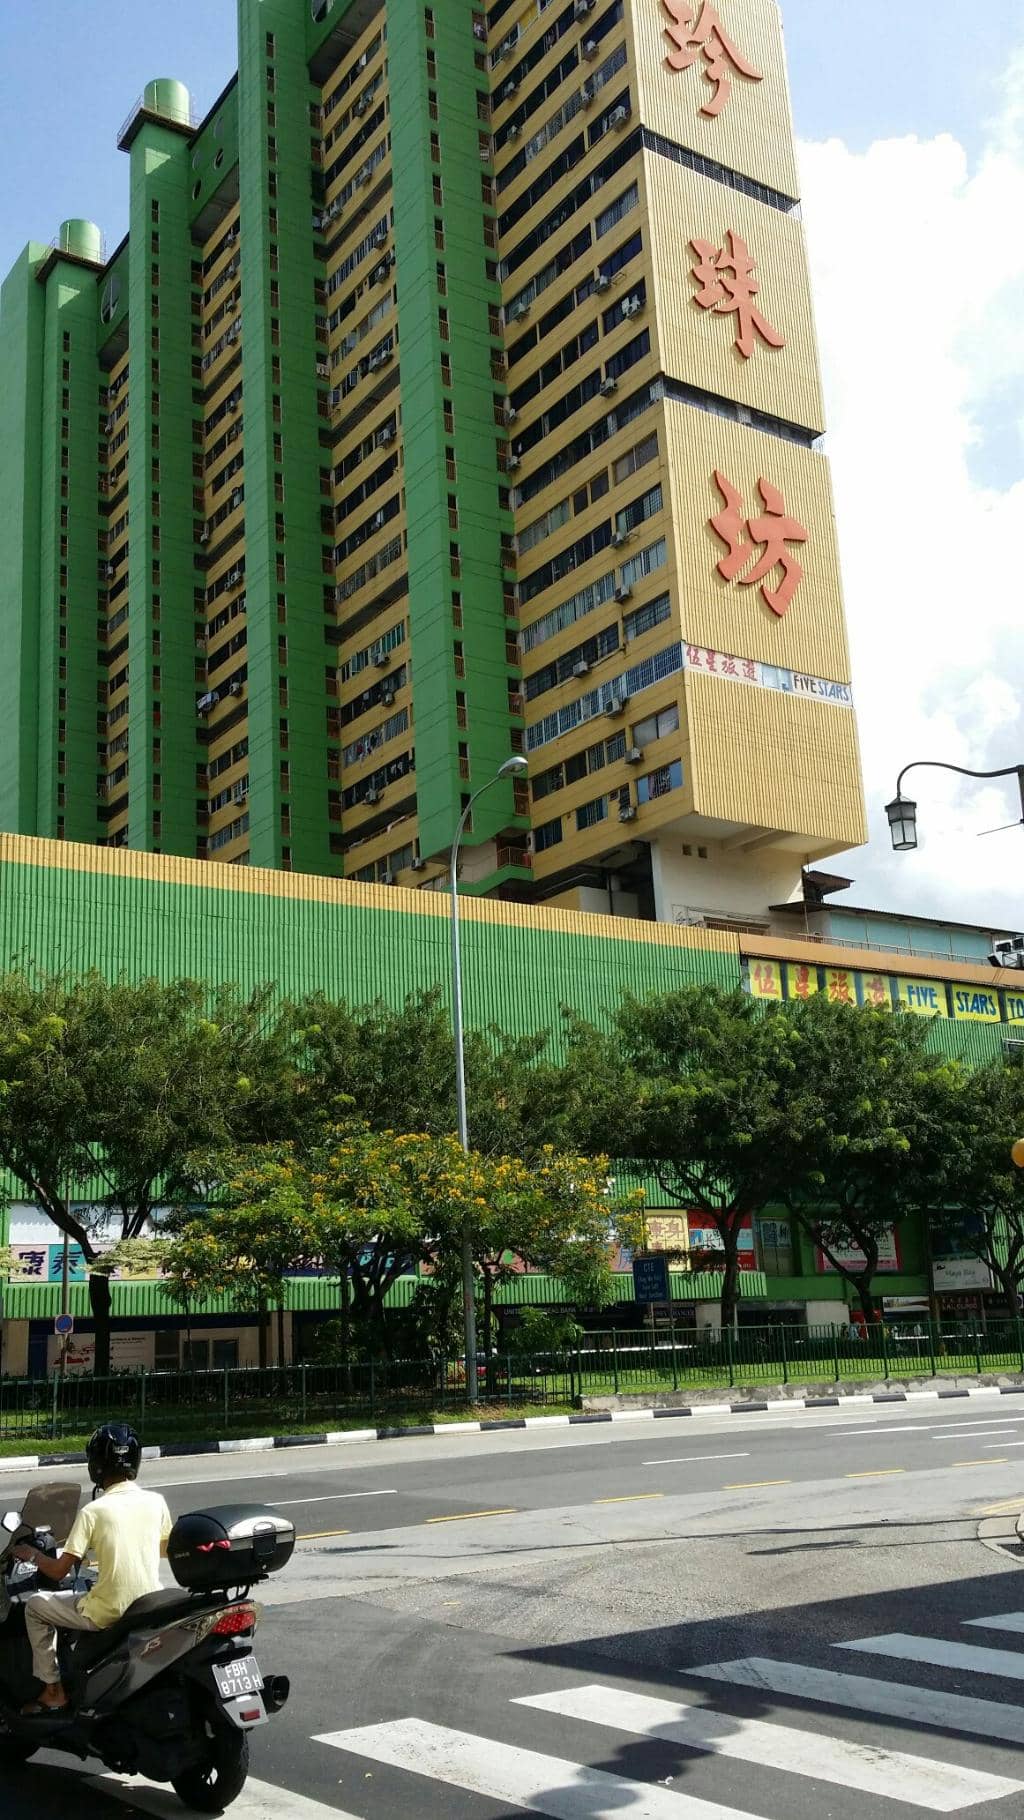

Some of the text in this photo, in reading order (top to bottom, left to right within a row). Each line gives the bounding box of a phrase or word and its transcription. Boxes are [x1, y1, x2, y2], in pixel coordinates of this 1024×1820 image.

[794, 674, 849, 702] FIVE STARS
[907, 985, 938, 1009] FIVE
[955, 991, 997, 1016] STARS
[224, 1661, 248, 1678] FBH
